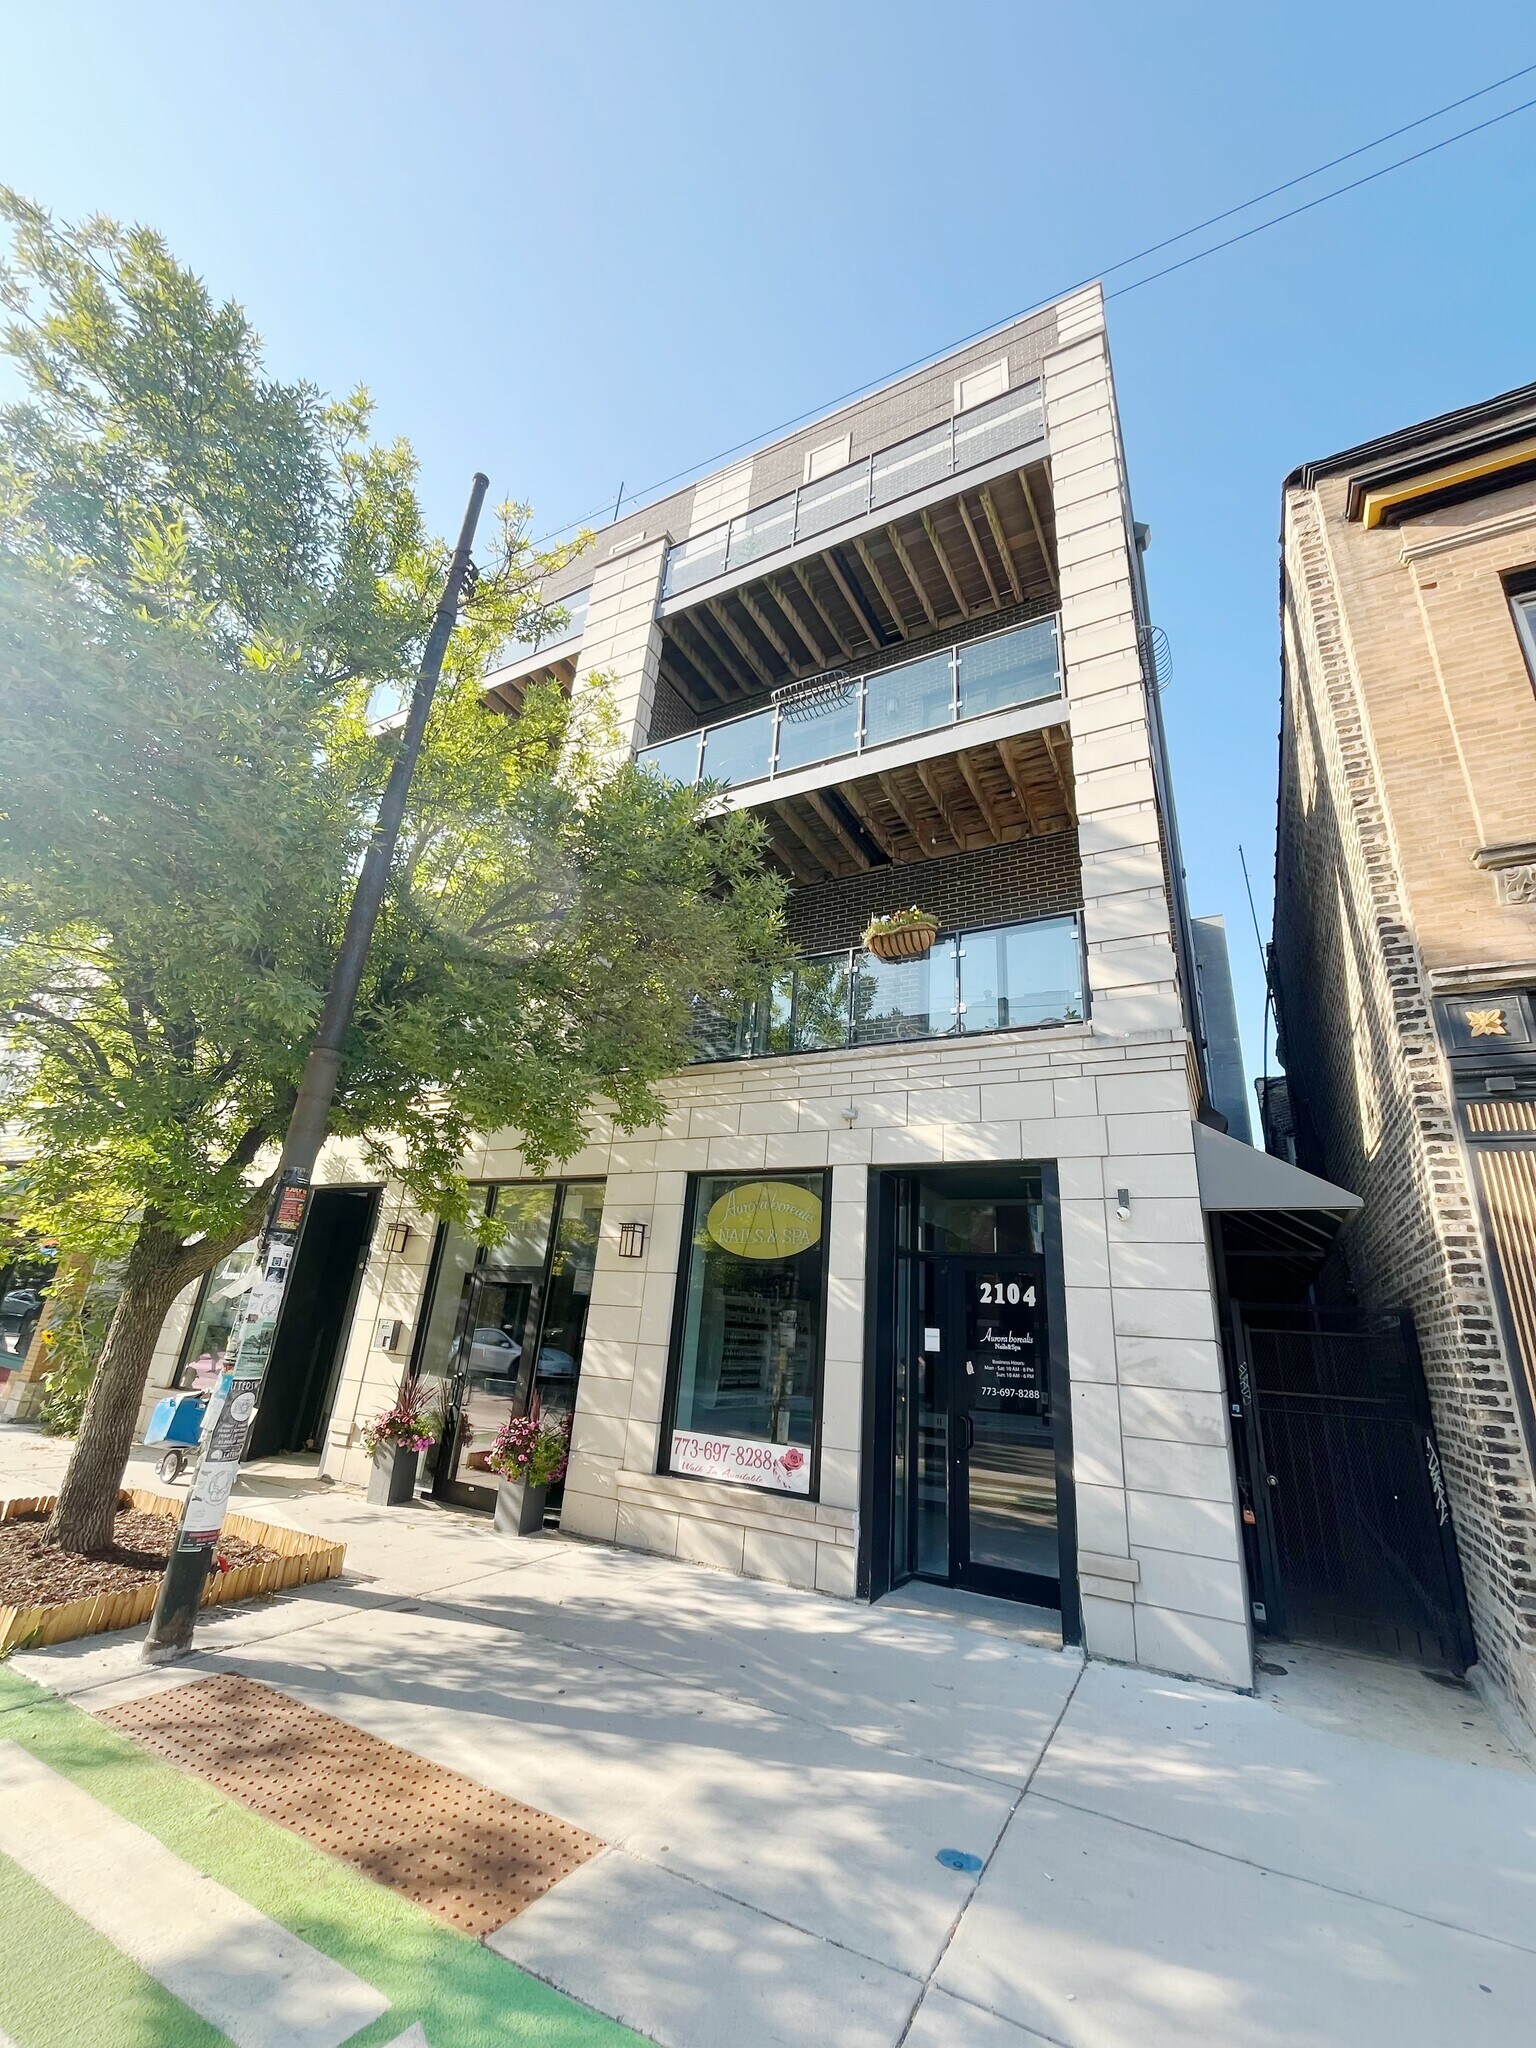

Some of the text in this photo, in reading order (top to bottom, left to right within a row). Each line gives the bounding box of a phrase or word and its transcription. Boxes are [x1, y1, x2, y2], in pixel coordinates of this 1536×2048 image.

[718, 1189, 816, 1225] Aurora borealis
[719, 1228, 811, 1245] NAILS & SPA
[980, 1282, 1036, 1307] 2104
[980, 1327, 1034, 1344] Aurora borealis
[981, 1387, 1040, 1399] 773-697-8288
[674, 1436, 772, 1470] 773-697-8288
[681, 1461, 763, 1483] Walk In Available
